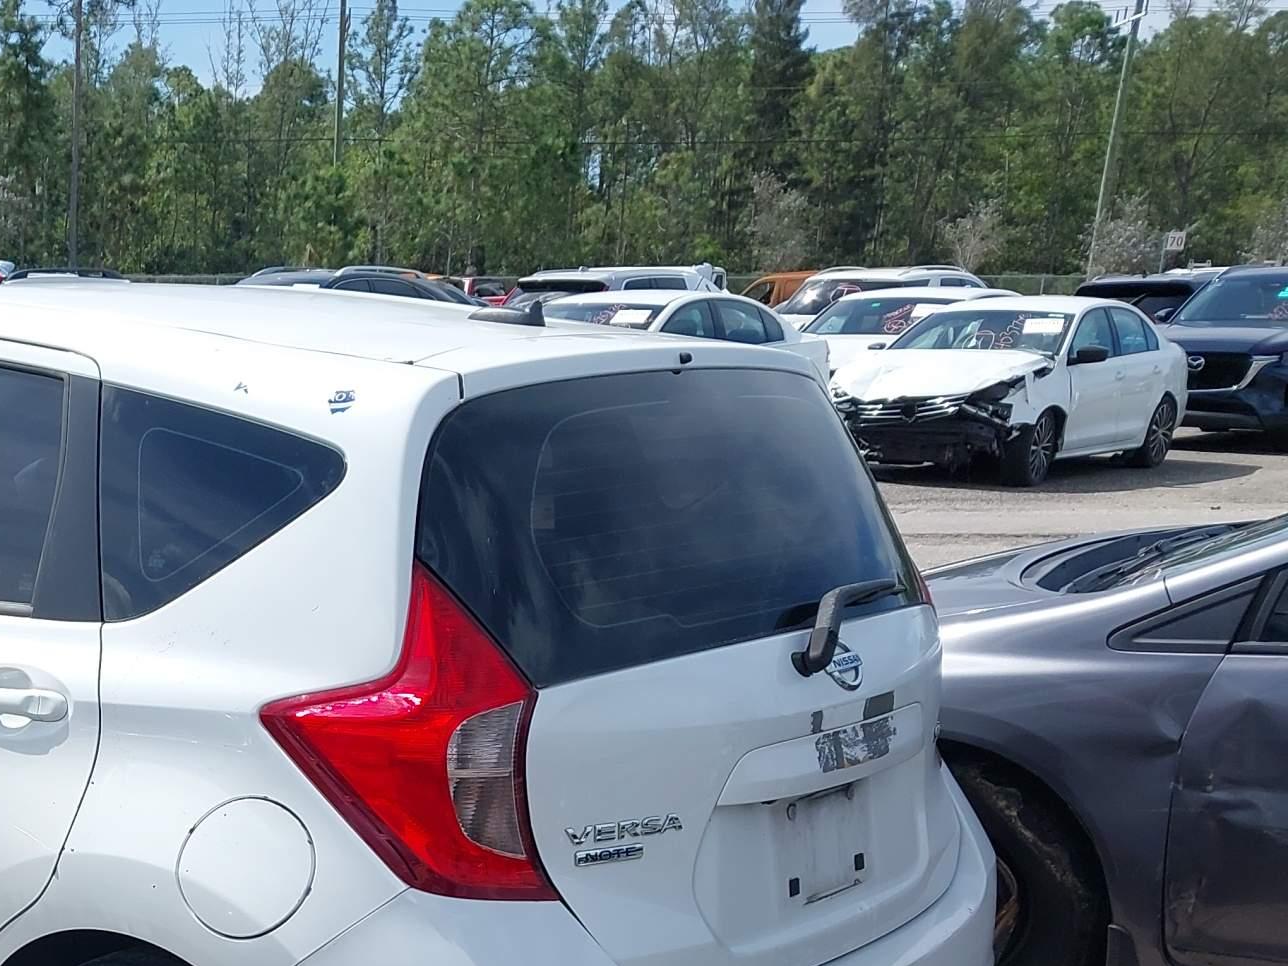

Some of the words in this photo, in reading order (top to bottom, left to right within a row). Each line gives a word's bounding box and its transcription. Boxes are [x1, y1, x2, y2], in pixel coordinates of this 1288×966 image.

[1168, 235, 1184, 248] 70
[564, 812, 684, 846] VERSA
[578, 845, 642, 866] NOTE
